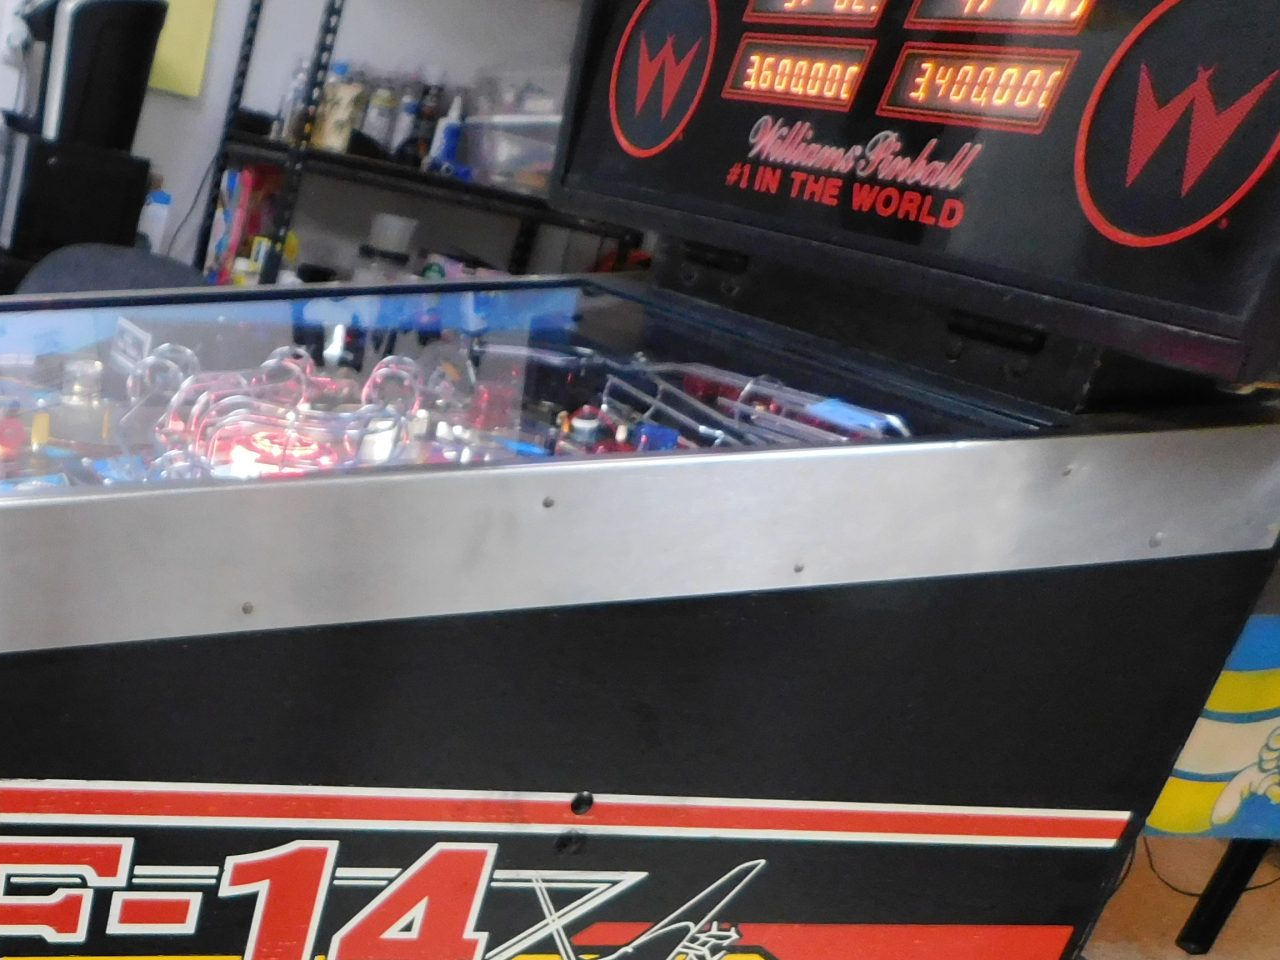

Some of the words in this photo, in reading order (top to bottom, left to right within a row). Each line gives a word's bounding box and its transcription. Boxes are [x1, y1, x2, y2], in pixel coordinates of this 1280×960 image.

[748, 115, 862, 173] Williams
[857, 130, 984, 190] Pinball
[725, 162, 750, 189] #1
[754, 166, 782, 194] IN
[790, 171, 843, 207] THE
[851, 182, 965, 229] WORLD
